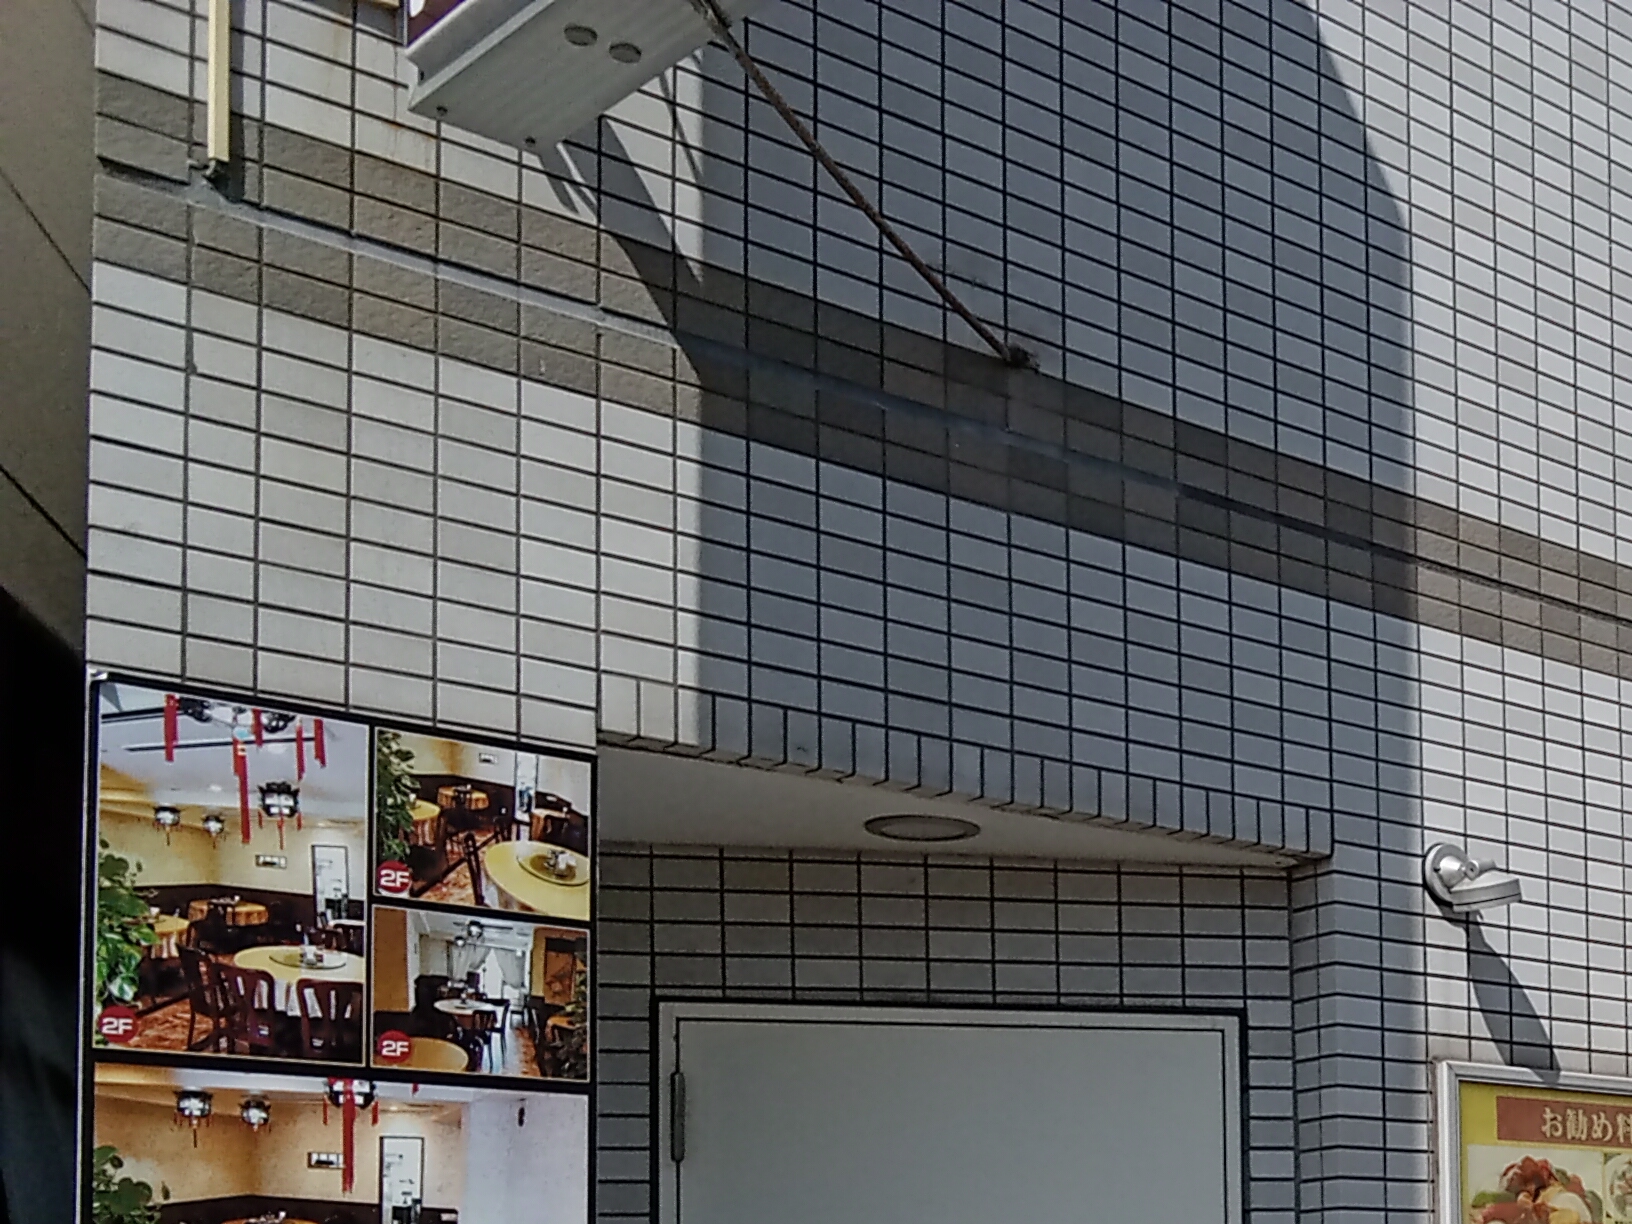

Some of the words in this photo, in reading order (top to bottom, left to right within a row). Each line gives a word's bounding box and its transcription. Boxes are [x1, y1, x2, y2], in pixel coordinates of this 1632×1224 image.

[380, 869, 409, 887] 2F
[101, 1016, 133, 1035] 2F
[382, 1039, 410, 1058] 2F
